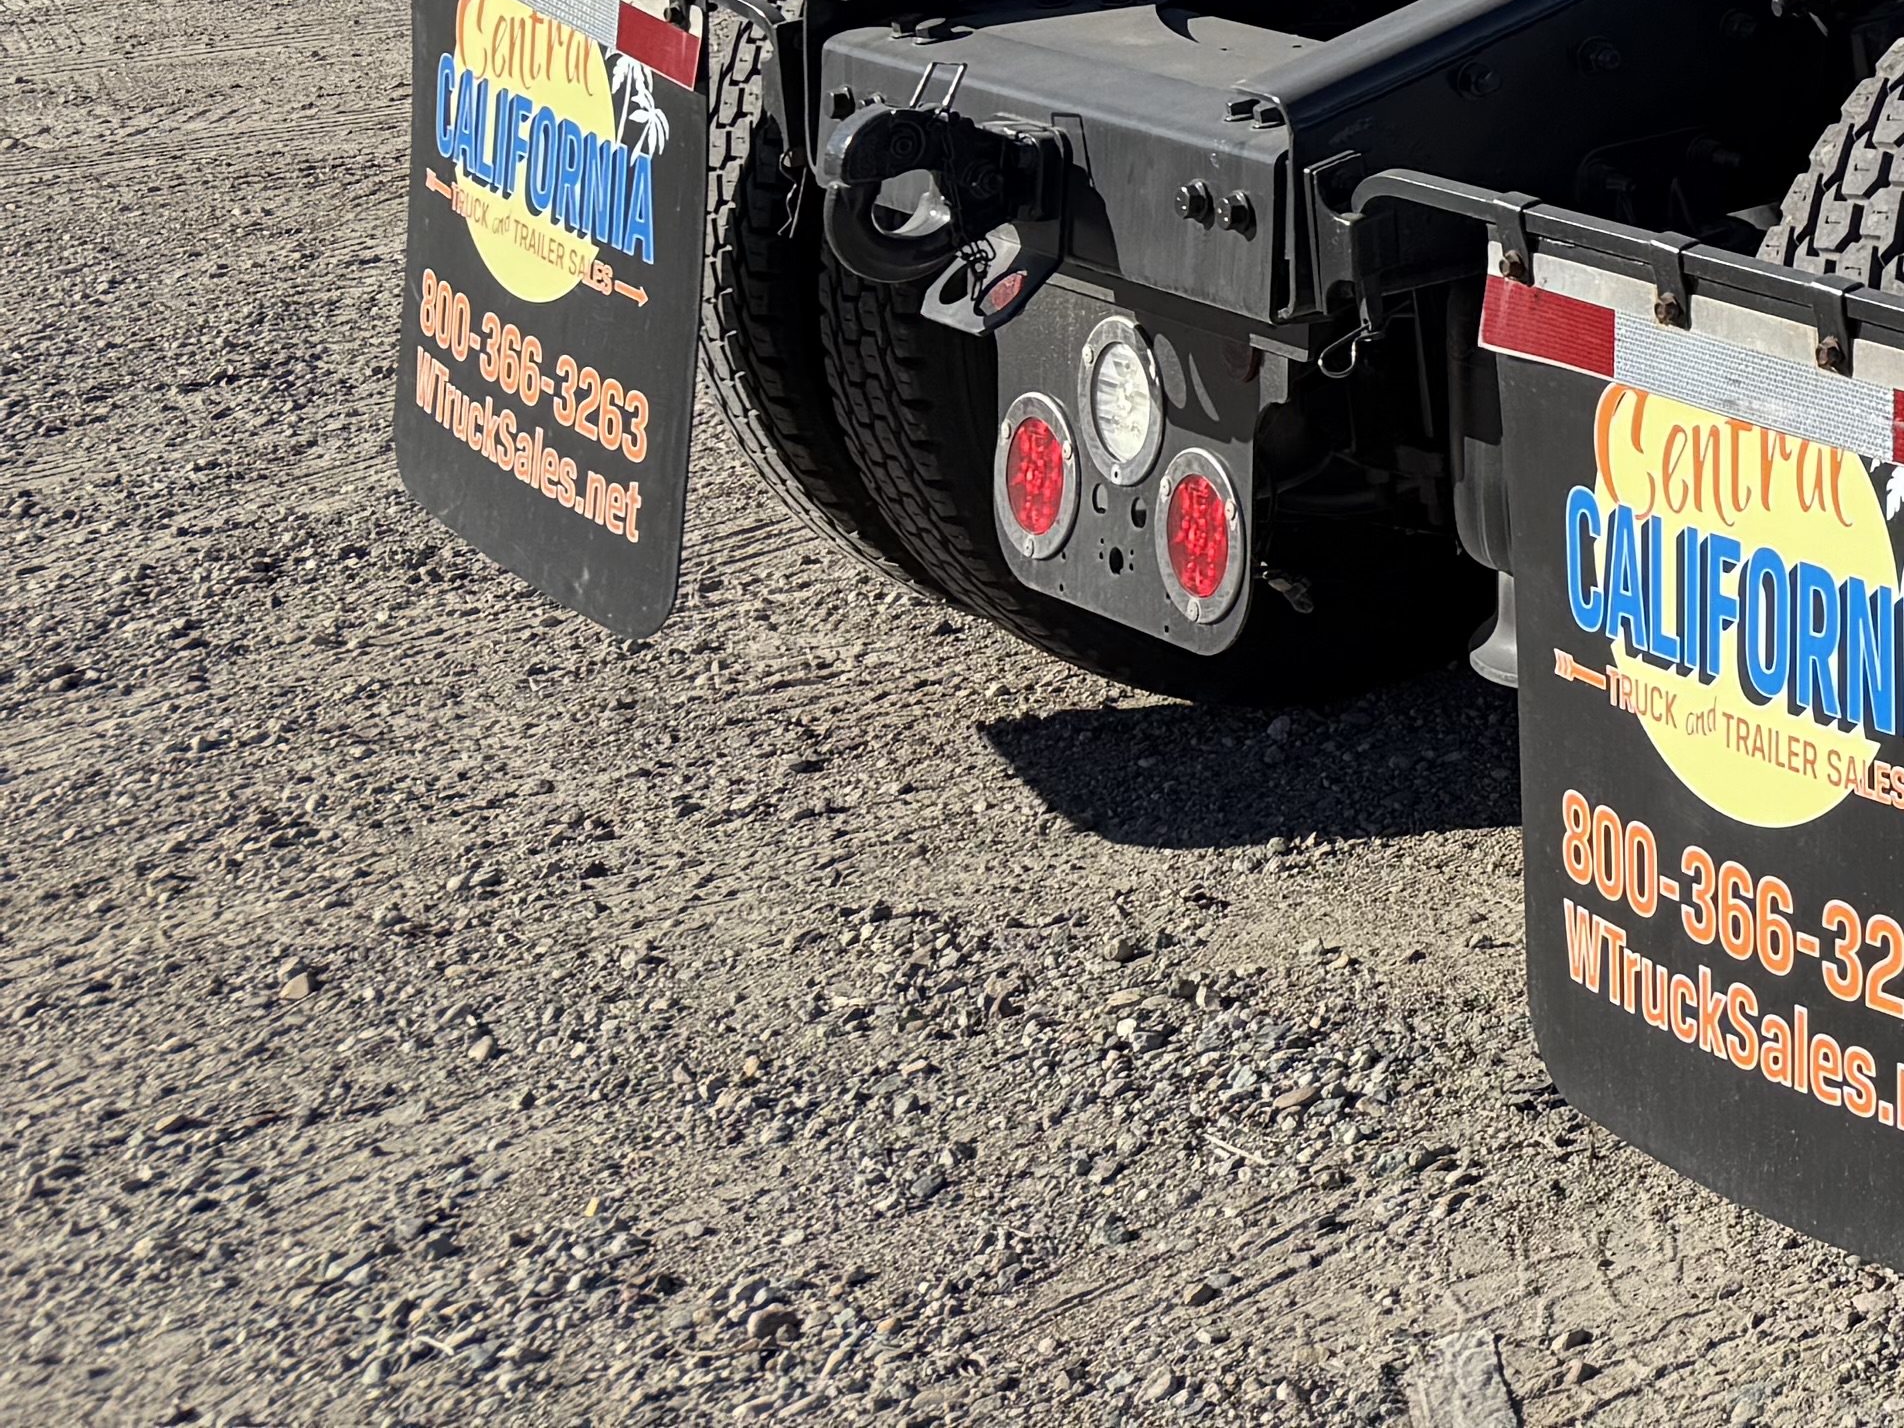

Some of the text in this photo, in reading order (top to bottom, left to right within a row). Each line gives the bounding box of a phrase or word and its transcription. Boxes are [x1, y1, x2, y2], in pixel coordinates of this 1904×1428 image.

[436, 53, 655, 265] CALIFORNIA
[451, 182, 613, 296] TRUCK and TRAILER SALES
[416, 345, 642, 544] WTruckSales.net
[419, 268, 650, 463] 800-366-3263
[1606, 665, 1678, 730] TRUCK
[1686, 696, 1717, 736] and
[1722, 712, 1818, 780] TRAILER
